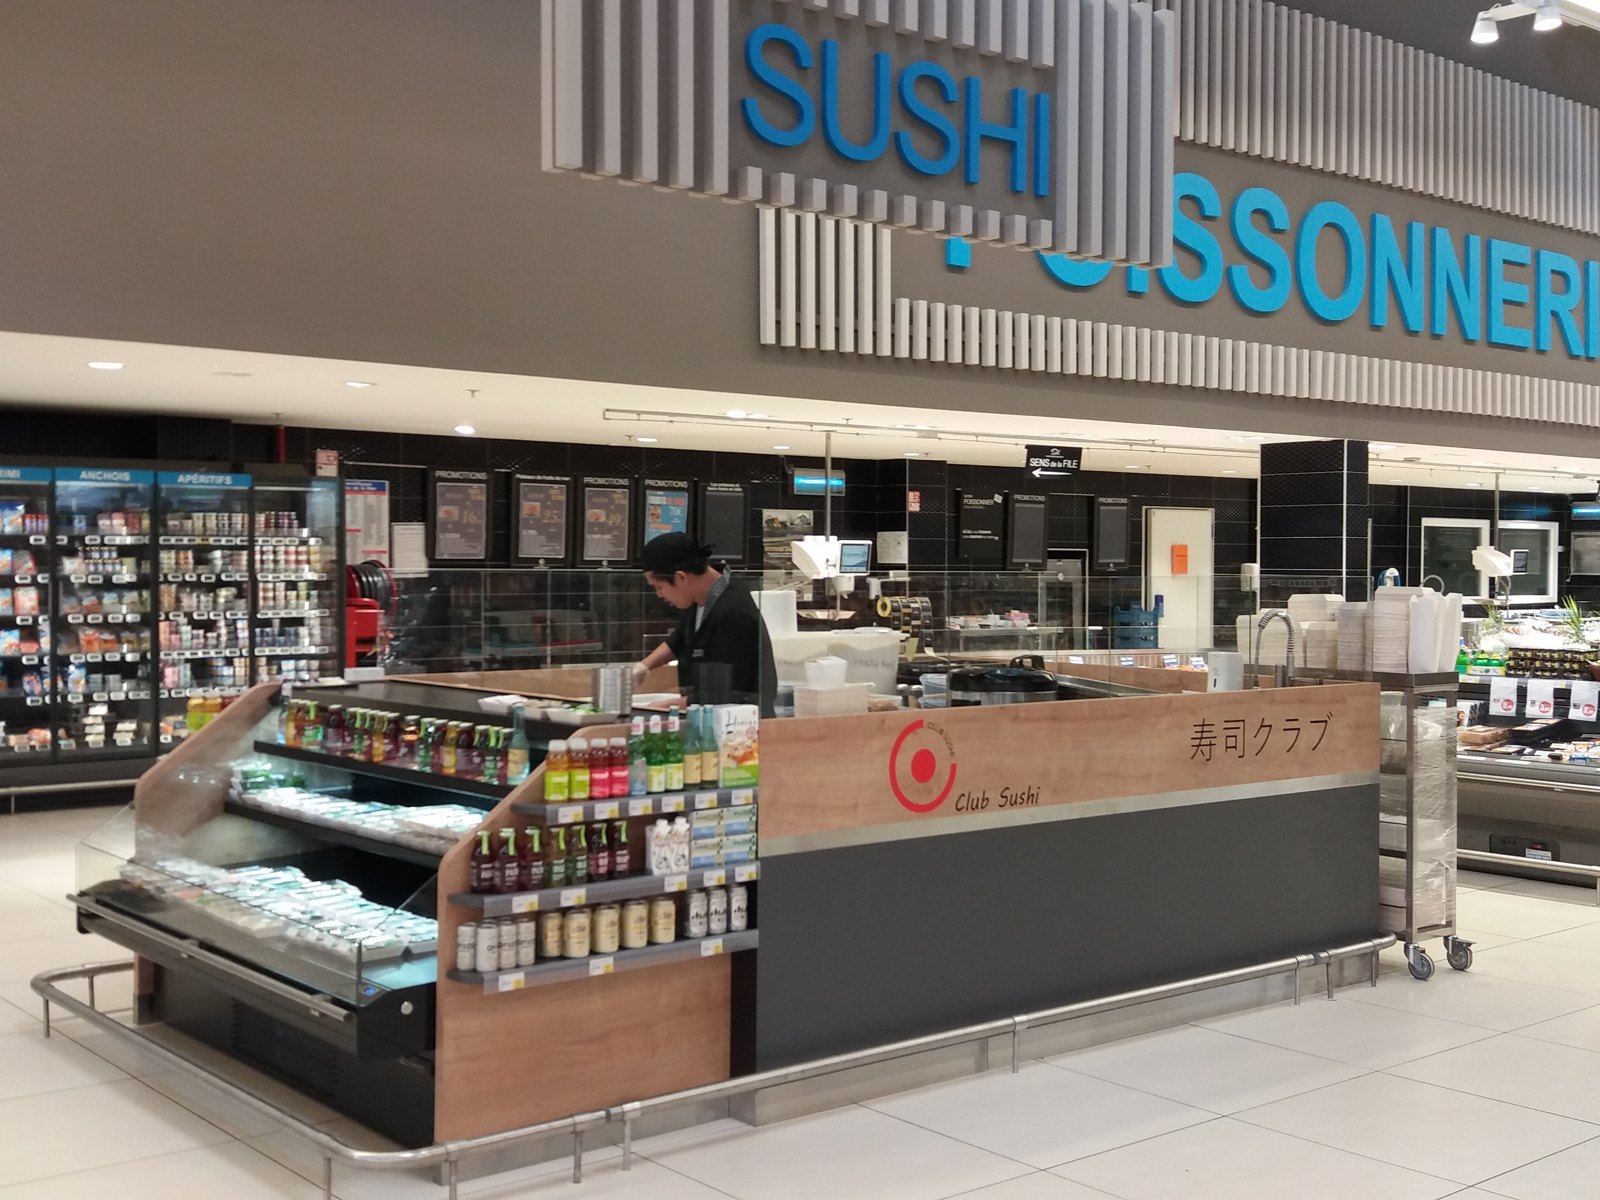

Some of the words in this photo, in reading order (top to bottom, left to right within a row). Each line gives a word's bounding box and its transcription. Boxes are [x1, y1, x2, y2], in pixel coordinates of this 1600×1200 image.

[741, 23, 1050, 198] SUSHI
[945, 172, 1600, 358] SSONNERI
[1029, 457, 1050, 467] SENS
[1063, 459, 1078, 469] FILE
[79, 470, 131, 482] ANCHOIS
[177, 474, 233, 486] APÉRITIFS
[435, 470, 488, 480] PROMOTIONS
[583, 476, 630, 486] PROMOTIONS
[644, 479, 689, 489] PROMOTIONS
[1013, 493, 1046, 502] PROMOTIONS
[1190, 711, 1335, 762] 寿司クラブ
[955, 789, 990, 812] Club
[998, 785, 1041, 808] Sushi
